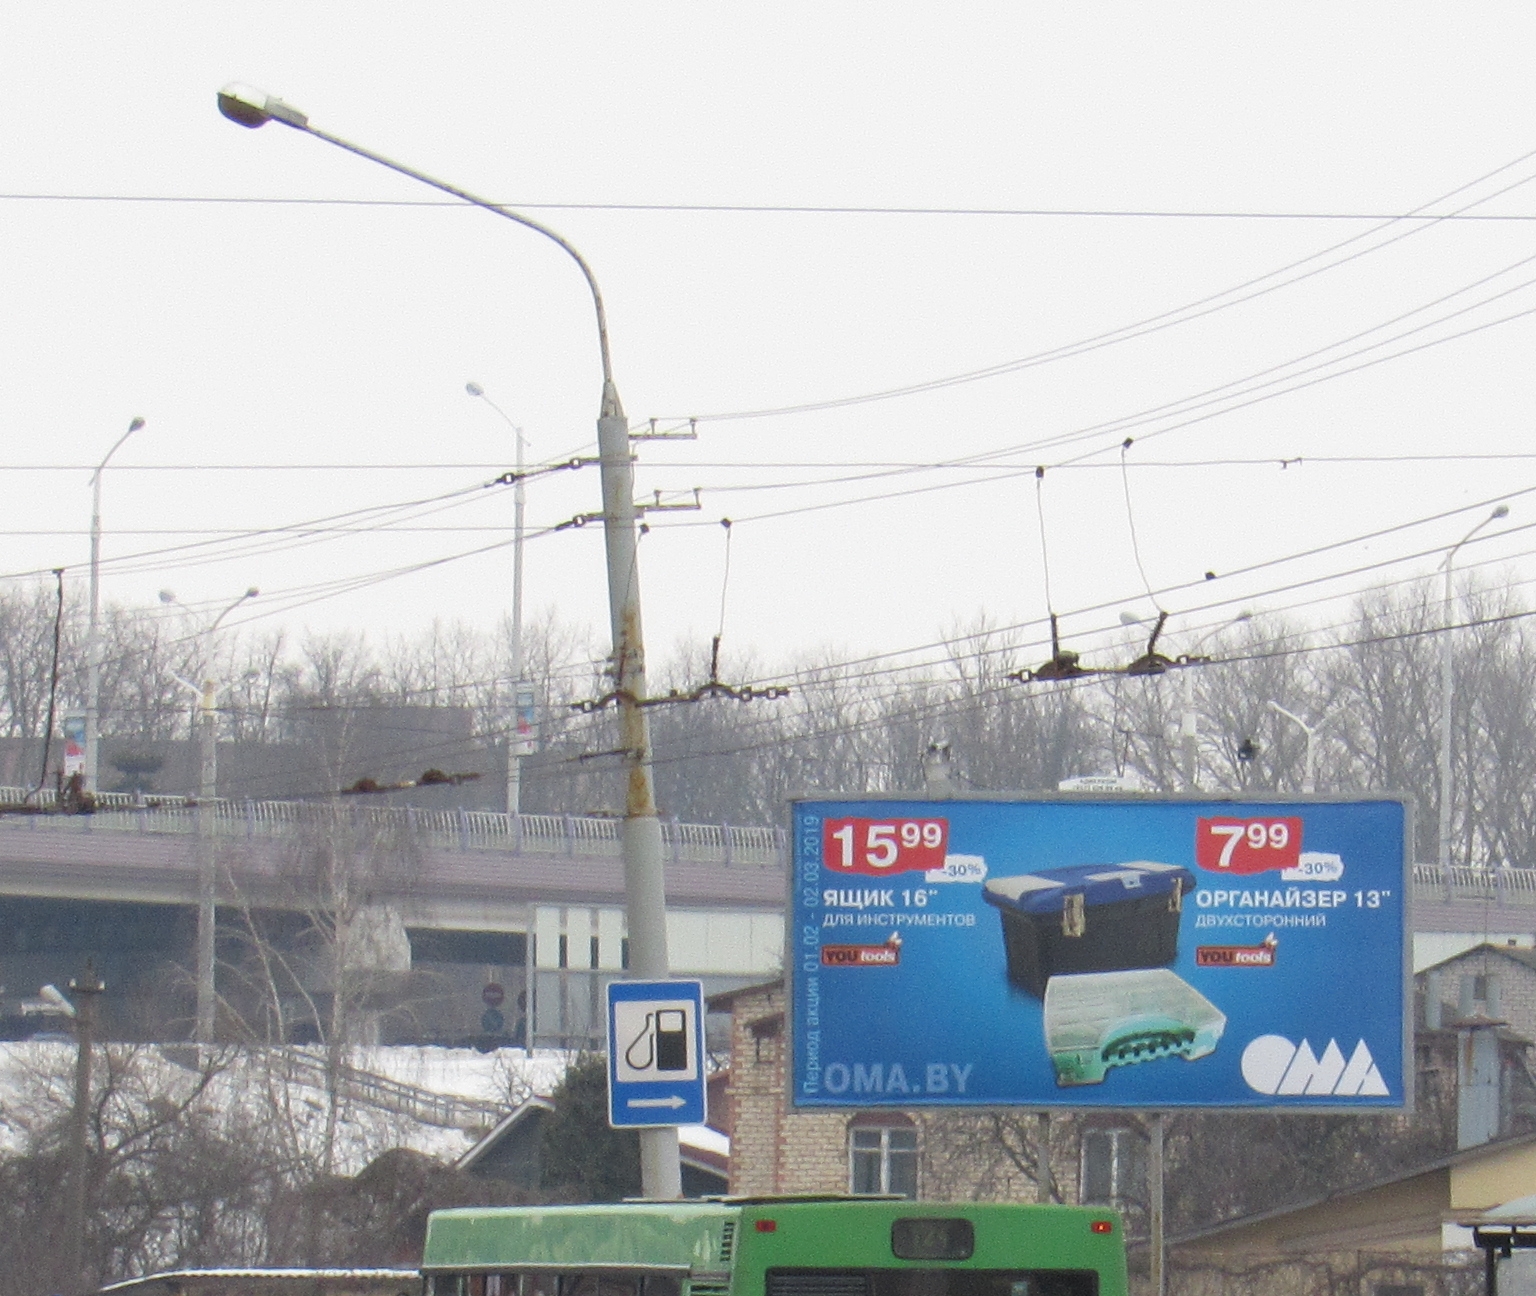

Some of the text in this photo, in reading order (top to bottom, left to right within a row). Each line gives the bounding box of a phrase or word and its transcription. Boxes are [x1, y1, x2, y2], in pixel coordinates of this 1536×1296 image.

[803, 815, 820, 908] 02.03.2019
[942, 864, 981, 878] -30%
[823, 888, 894, 909] ЯЩИК
[1195, 886, 1391, 909] ОРГАНАЙЗЕР 13"
[822, 913, 976, 928] ДЛЯ ИНСТРУМЕНТОВ
[1195, 912, 1327, 928] ДВУХСТОРОННИЙ
[803, 924, 820, 972] 01.02
[825, 949, 897, 963] YOU tools
[1200, 949, 1273, 964] YOU tools
[805, 977, 821, 1026] акции
[802, 1030, 821, 1094] Период
[823, 1061, 974, 1094] OMA.BY
